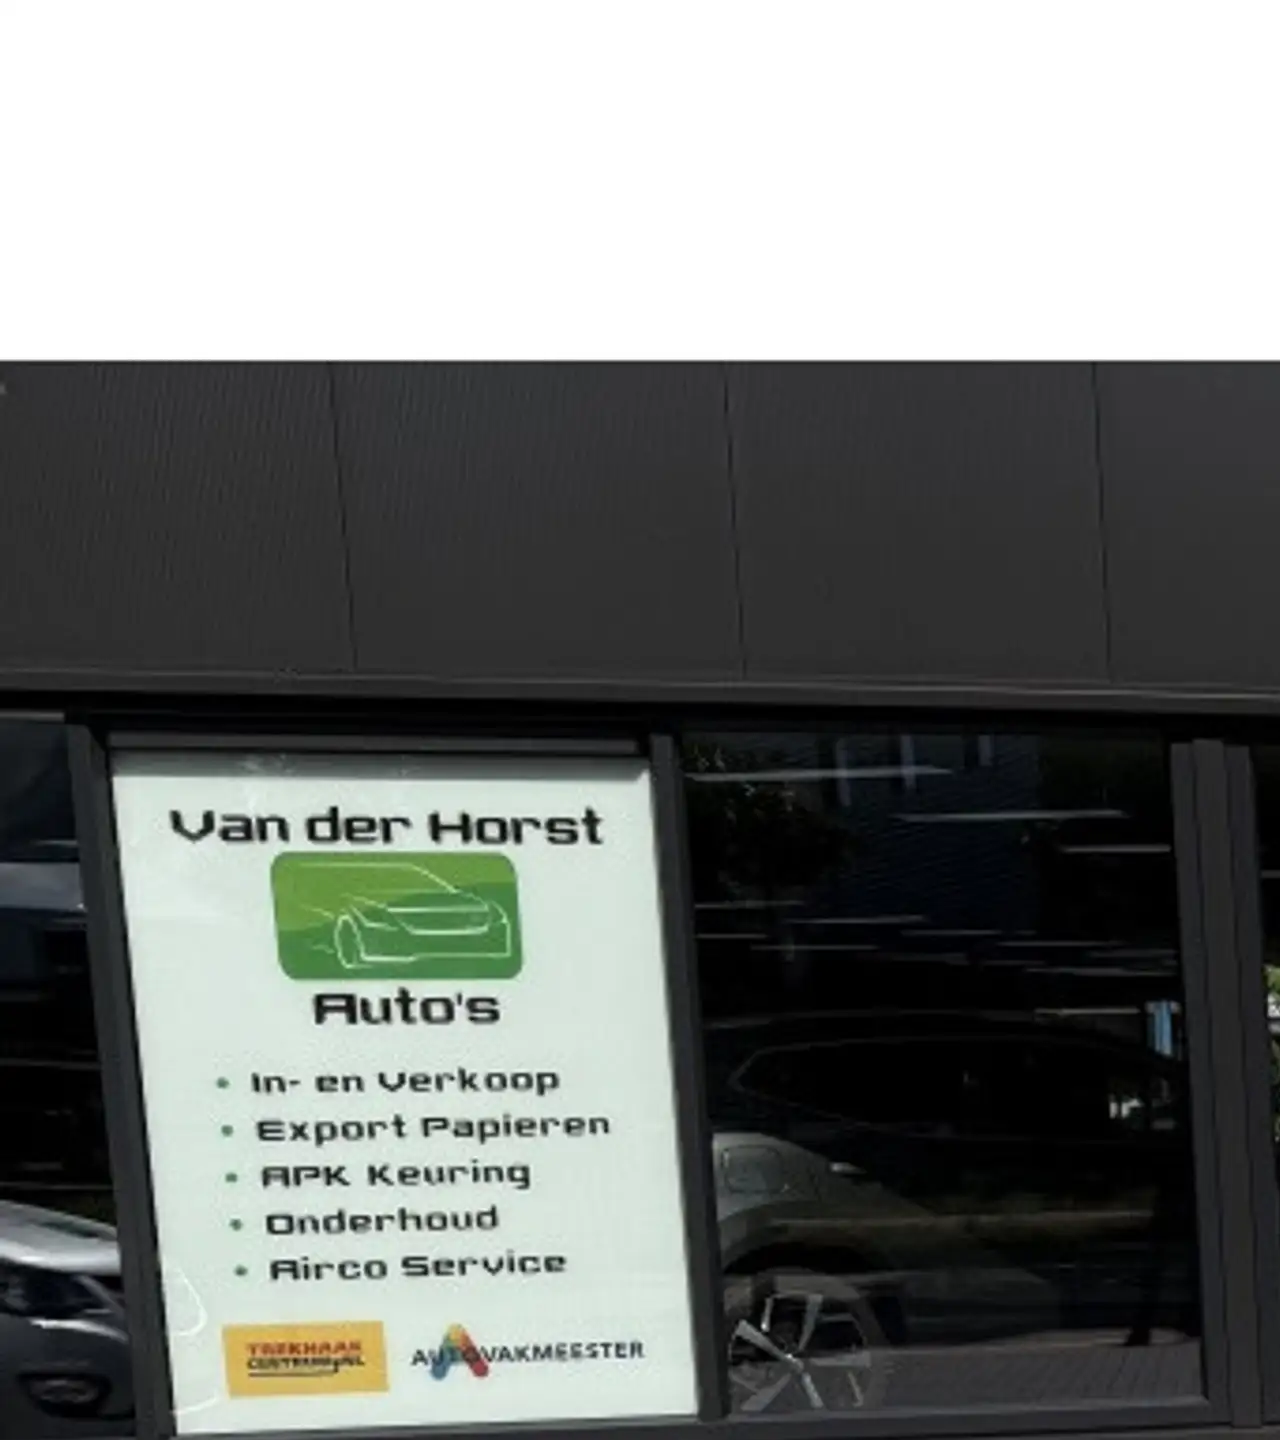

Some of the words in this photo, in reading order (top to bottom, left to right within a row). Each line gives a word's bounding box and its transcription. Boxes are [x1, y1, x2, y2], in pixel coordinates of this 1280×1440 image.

[171, 811, 289, 842] Van
[306, 806, 411, 843] der
[429, 808, 602, 844] Horst
[313, 988, 499, 1024] Auto's
[252, 1073, 300, 1093] In-
[316, 1076, 364, 1092] en
[378, 1068, 559, 1096] Verkoop
[257, 1115, 405, 1146] Export
[422, 1115, 609, 1144] Papieren
[262, 1166, 350, 1187] APK
[368, 1160, 530, 1189] Keuring
[266, 1206, 498, 1235] Onderhoud
[270, 1257, 387, 1280] Airco
[402, 1256, 566, 1276] Service
